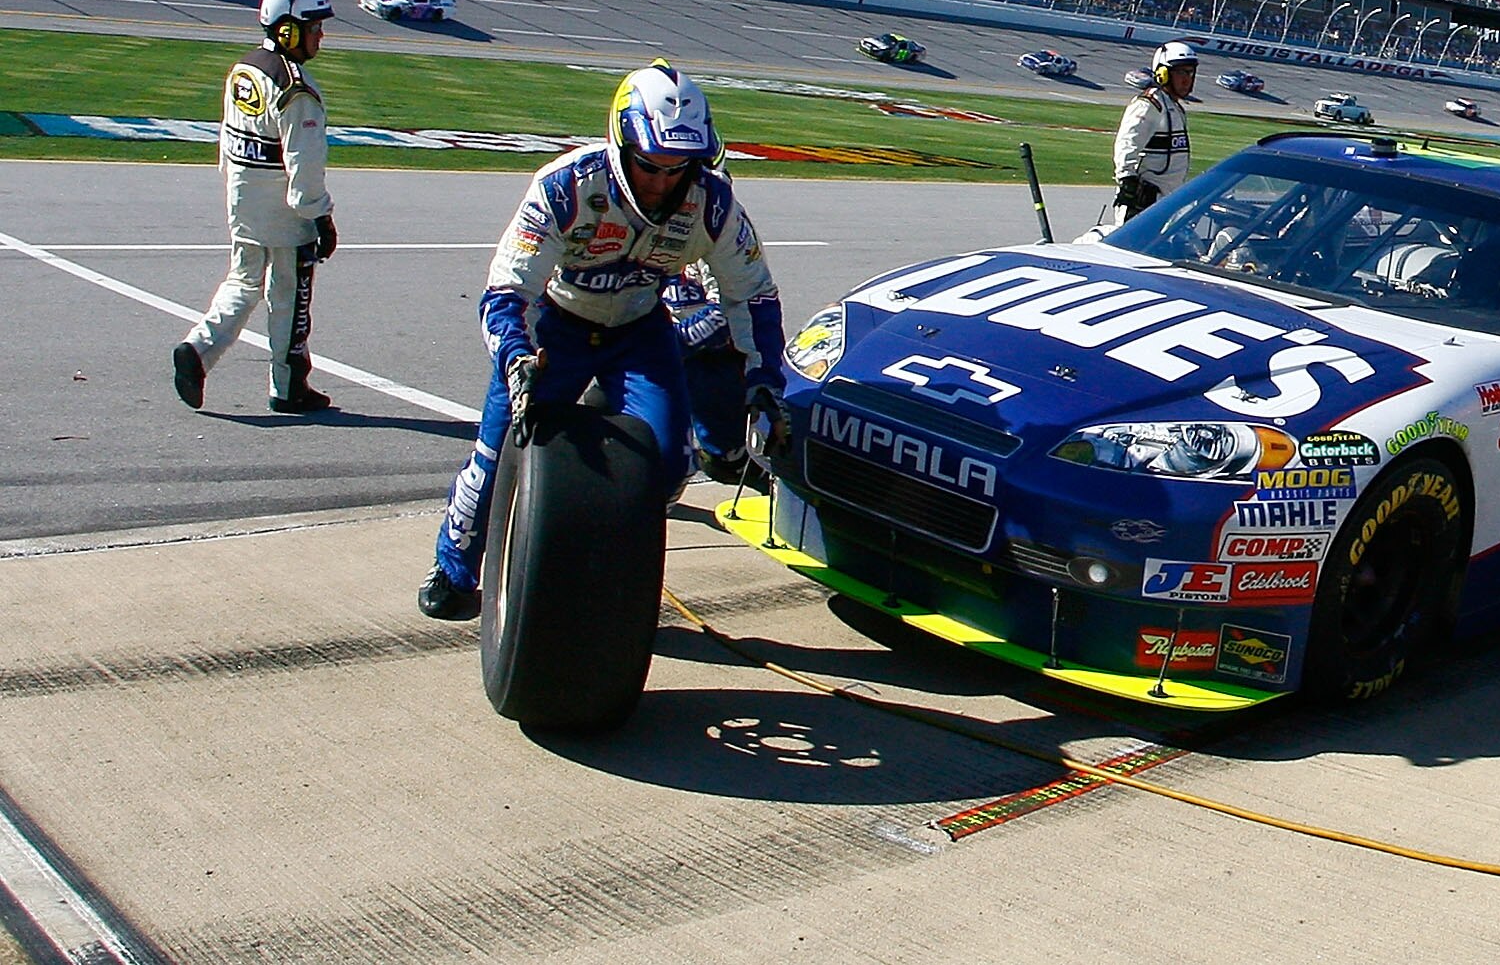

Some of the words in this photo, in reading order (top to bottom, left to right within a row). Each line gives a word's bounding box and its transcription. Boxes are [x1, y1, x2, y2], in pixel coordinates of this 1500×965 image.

[1216, 39, 1269, 56] THIS
[1270, 47, 1293, 59] IS
[1293, 50, 1426, 78] TALLADEGA
[845, 254, 1376, 419] LOWE'S
[1386, 411, 1470, 456] GOODYEAR
[810, 402, 997, 497] IMPALA
[1300, 444, 1374, 457] Gatorback
[1308, 456, 1374, 466] BELTS
[1258, 468, 1351, 490] MOOG
[1237, 500, 1337, 528] MAHLE
[1350, 472, 1461, 566] GOODYEAR
[1227, 538, 1305, 556] COMP
[1144, 563, 1228, 593] JE
[1238, 570, 1311, 592] Edelbrock
[1168, 591, 1228, 602] PISTONS
[1225, 640, 1283, 661] SUNOCO
